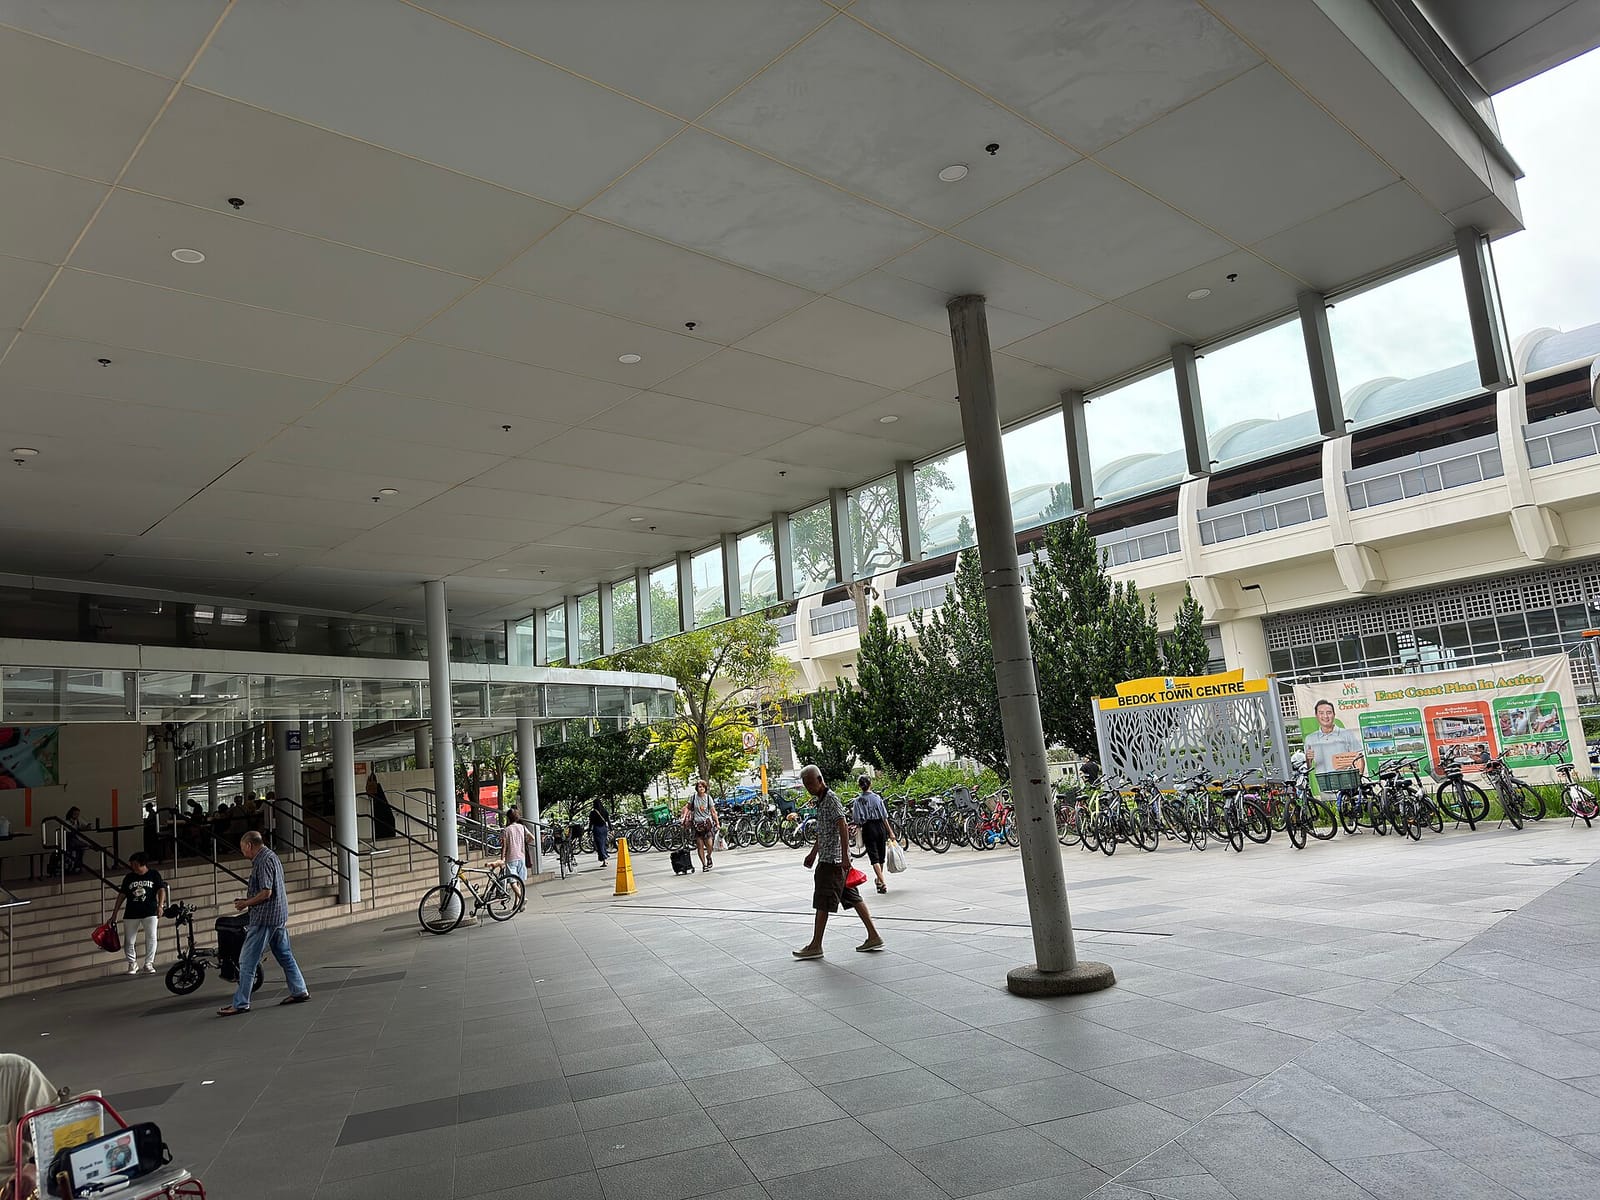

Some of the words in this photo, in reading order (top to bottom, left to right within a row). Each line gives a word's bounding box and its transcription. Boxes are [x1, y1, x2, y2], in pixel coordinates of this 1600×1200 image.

[1118, 693, 1157, 707] BEDOK
[1159, 688, 1193, 701] TOWN
[1196, 682, 1246, 697] CENTRE
[1375, 690, 1404, 701] East
[1405, 686, 1443, 699] Coast
[1444, 682, 1477, 694] Plan
[1478, 679, 1495, 690] In
[1496, 674, 1545, 688] Action
